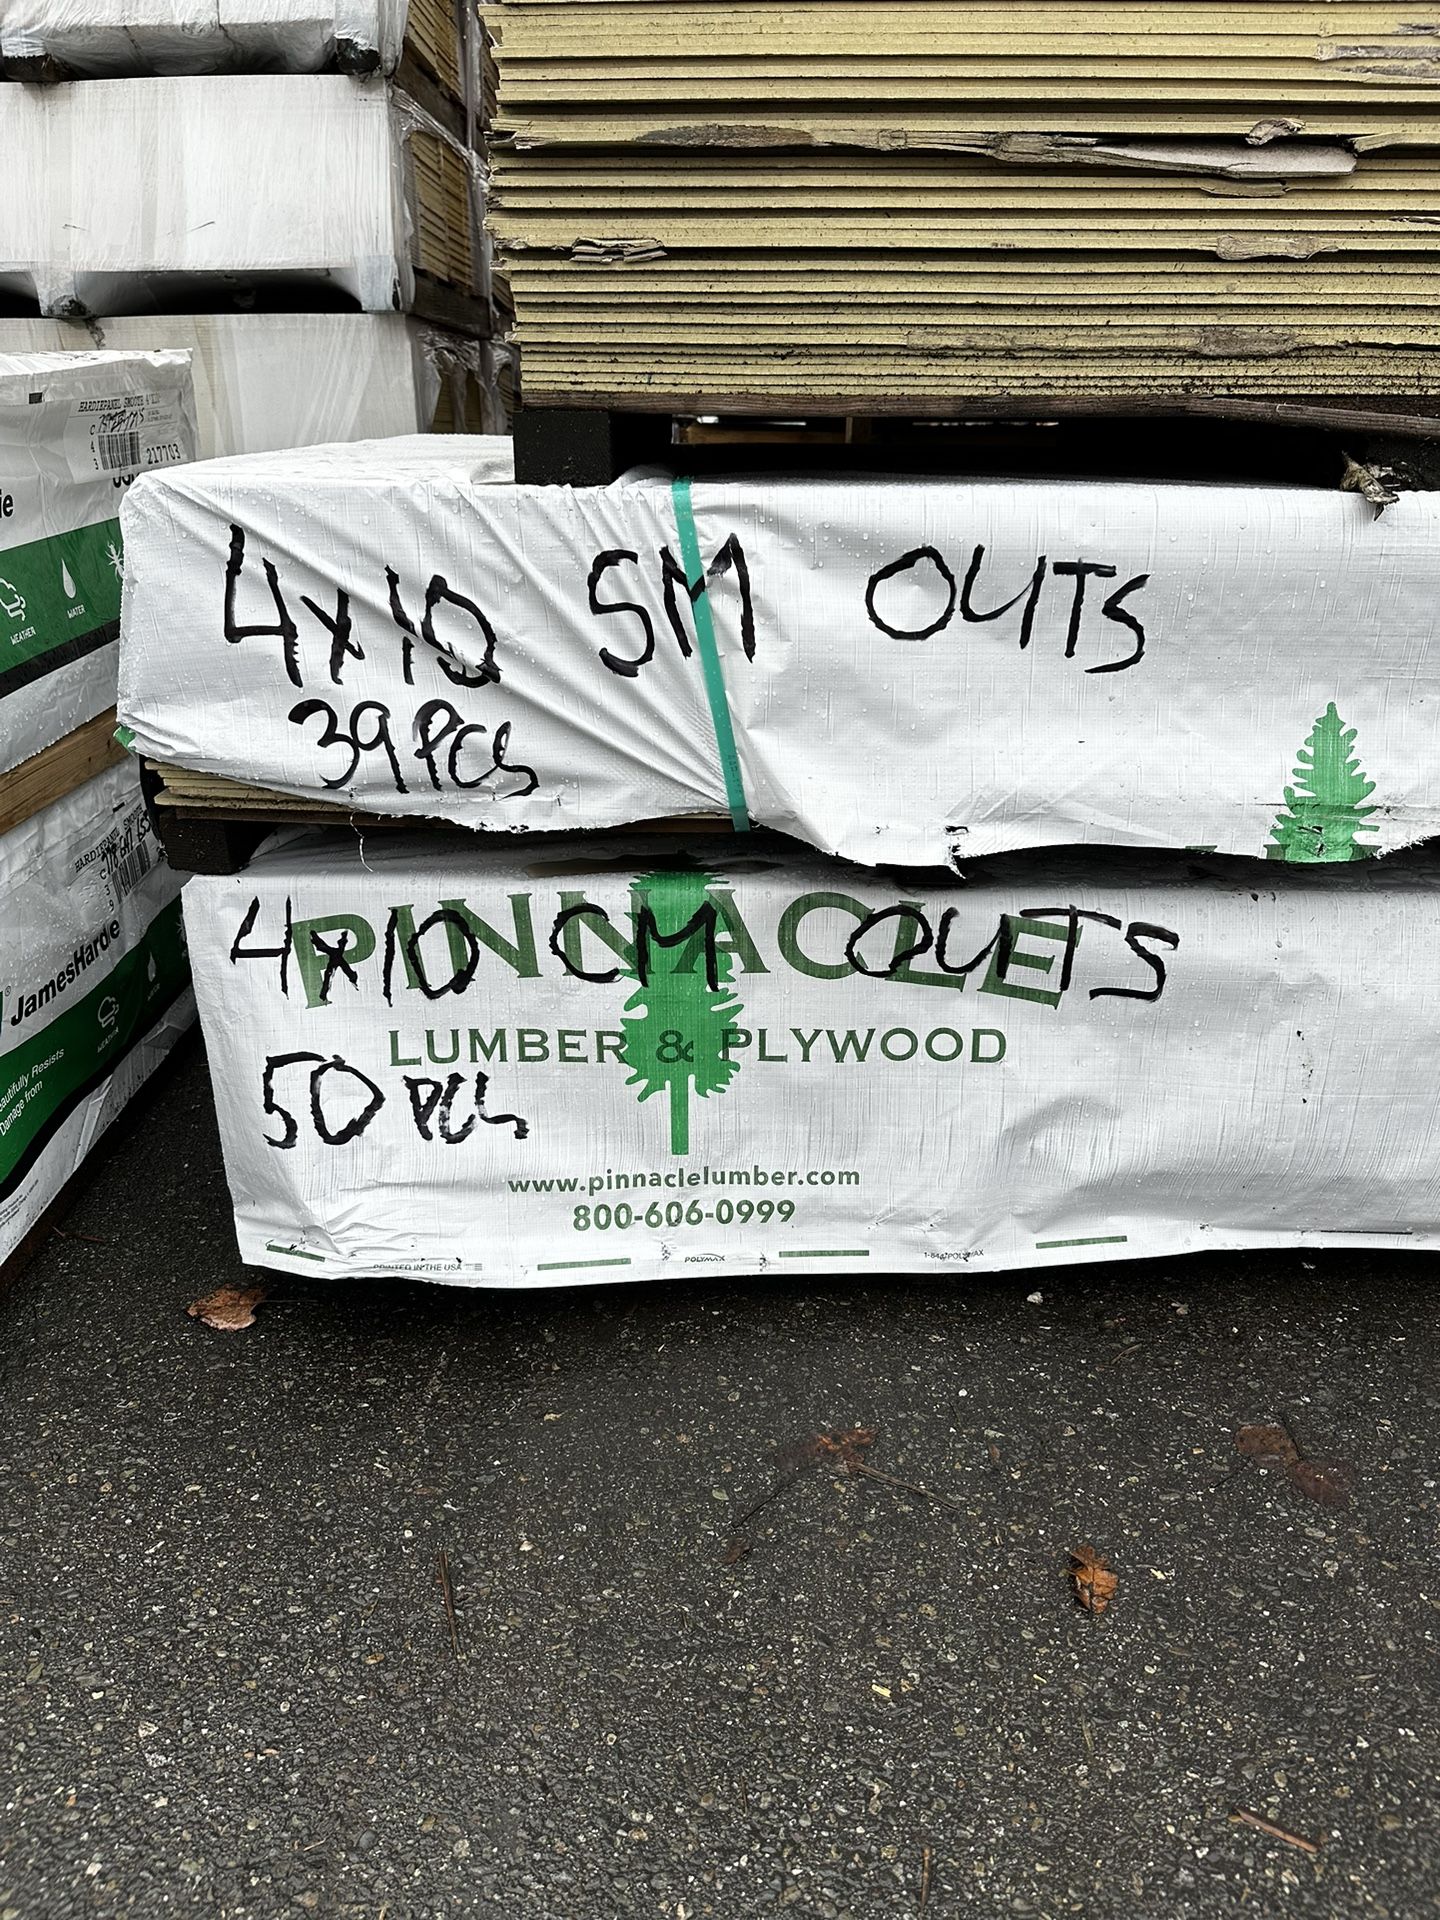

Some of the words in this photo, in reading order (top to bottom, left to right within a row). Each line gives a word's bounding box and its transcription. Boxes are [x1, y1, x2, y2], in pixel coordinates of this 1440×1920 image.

[146, 443, 181, 465] 217703
[67, 604, 86, 619] WATER
[587, 532, 756, 678] SM
[10, 626, 37, 645] WEATHER
[287, 698, 410, 795] 39
[291, 887, 1083, 1010] PINNACLE
[388, 1027, 628, 1067] LUMBER
[655, 1029, 694, 1063] &
[721, 1027, 1007, 1064] PLYWOOD
[31, 1048, 65, 1079] Resists
[0, 1099, 25, 1136] Damage
[24, 1080, 43, 1103] from
[262, 1050, 387, 1150] 50
[507, 1165, 861, 1197] www.pinnaclelumber.com
[572, 1199, 796, 1232] 800-606-0999
[424, 1263, 442, 1271] THE
[444, 1263, 463, 1271] USA
[684, 1253, 726, 1263] POLYMAX
